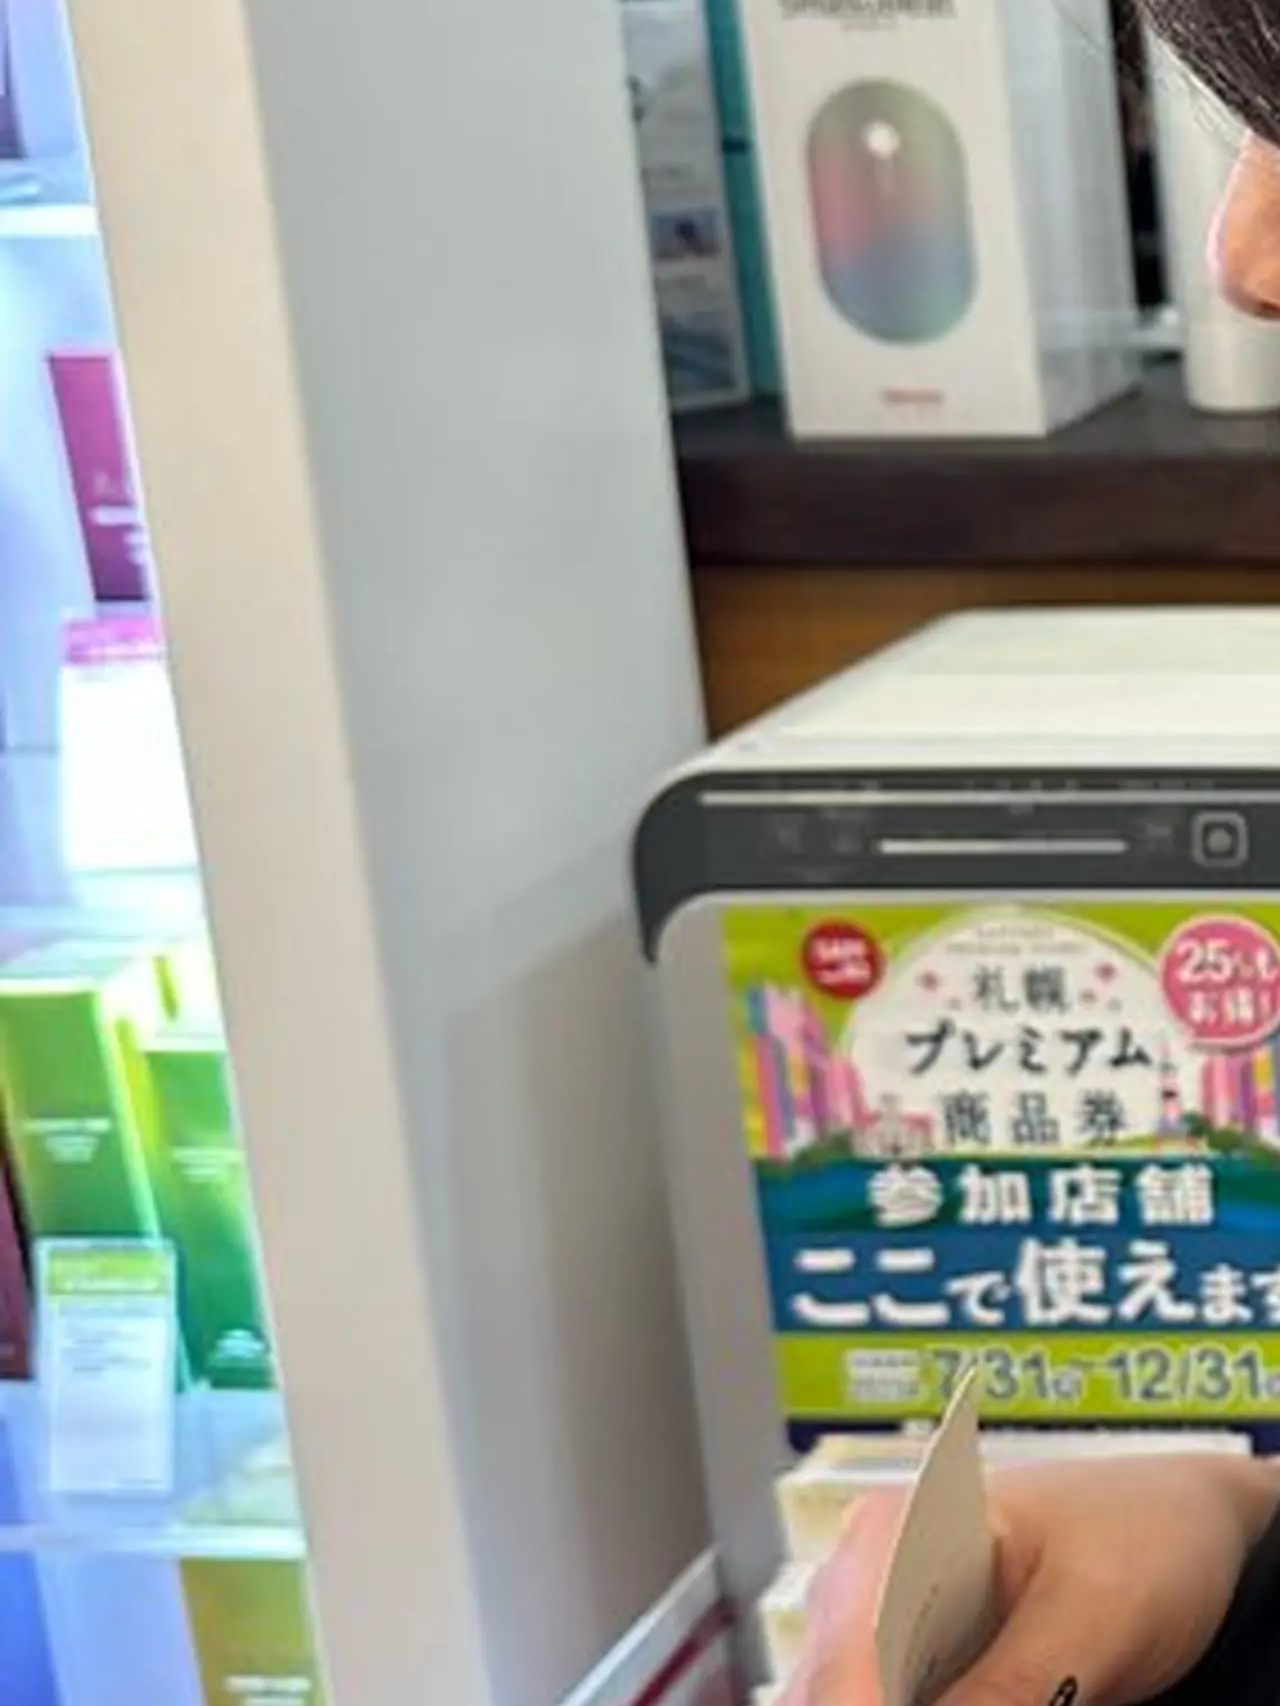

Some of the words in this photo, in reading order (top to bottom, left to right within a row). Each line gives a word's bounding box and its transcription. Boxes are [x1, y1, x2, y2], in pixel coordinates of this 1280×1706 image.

[973, 964, 1071, 1014] 札幌
[904, 1018, 1153, 1078] プレミアム
[942, 1089, 1128, 1146] 商品券
[866, 1161, 1215, 1226] 参加店舗
